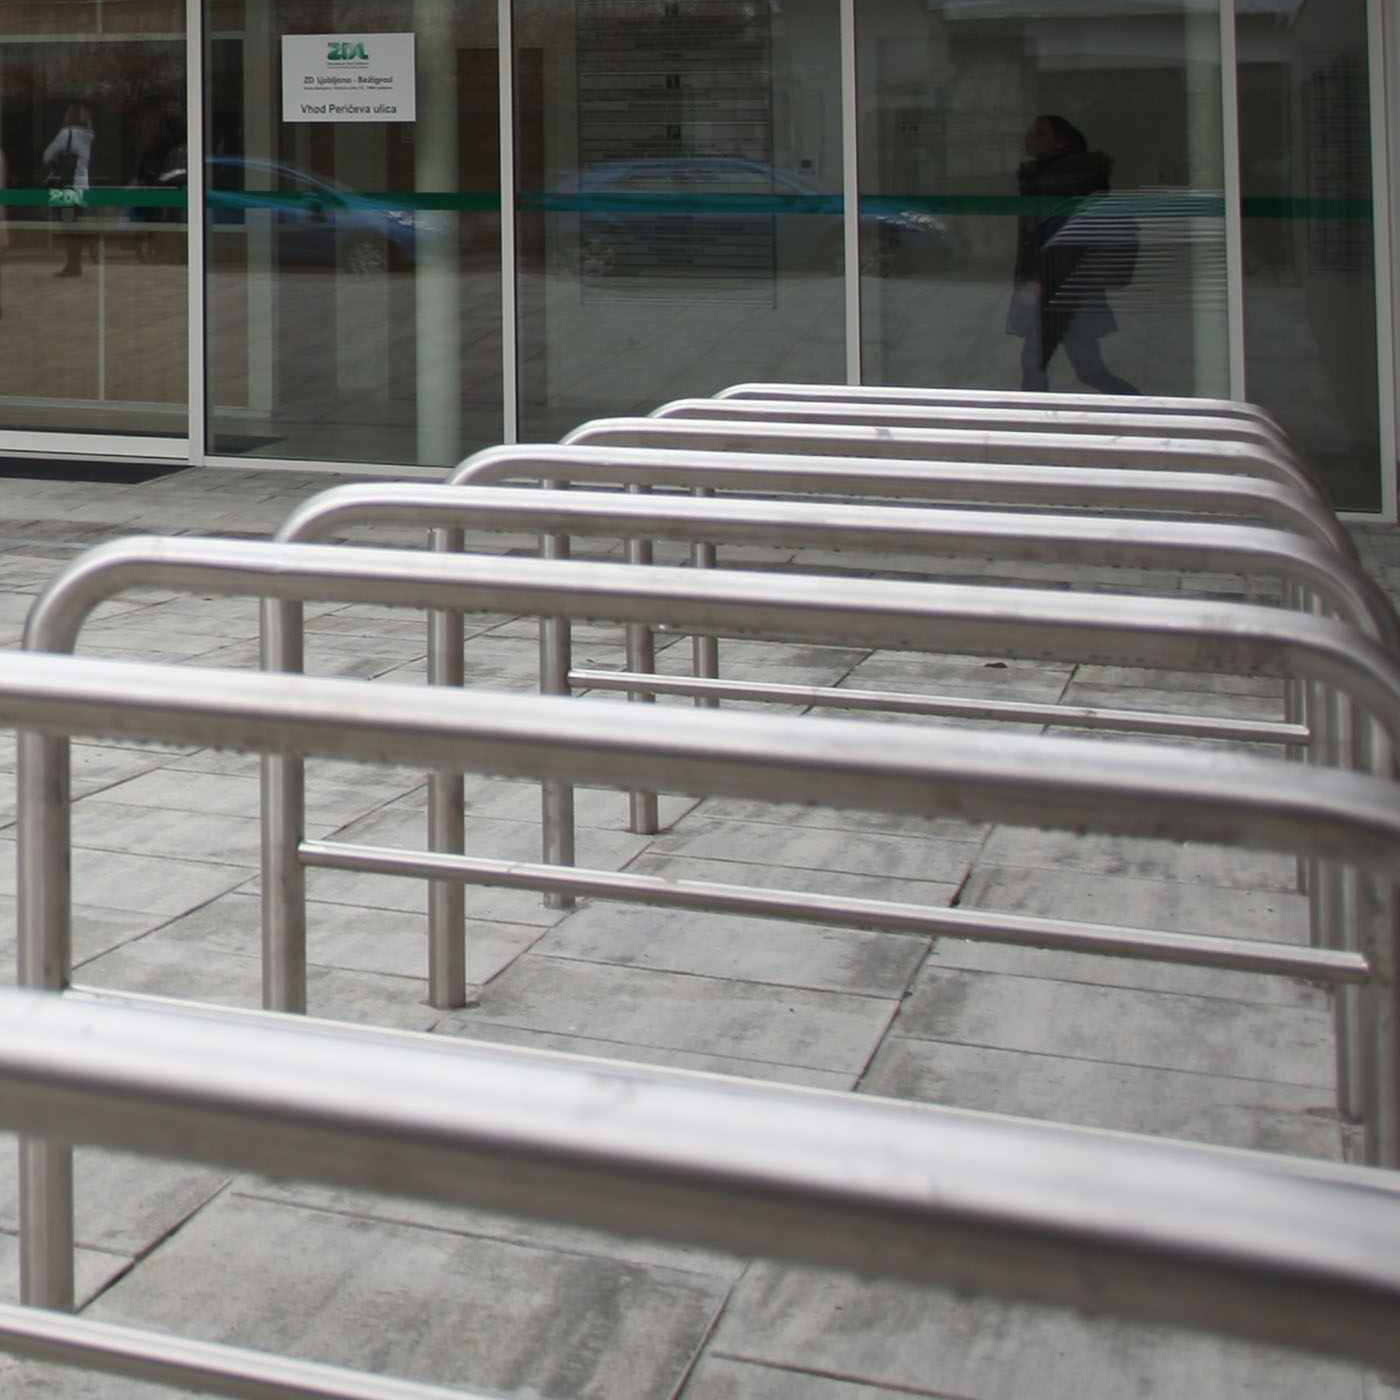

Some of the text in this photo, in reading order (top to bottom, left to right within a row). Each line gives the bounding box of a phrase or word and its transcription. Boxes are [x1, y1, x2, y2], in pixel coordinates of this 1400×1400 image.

[301, 103, 397, 114] Vhod Peričeva ulica
